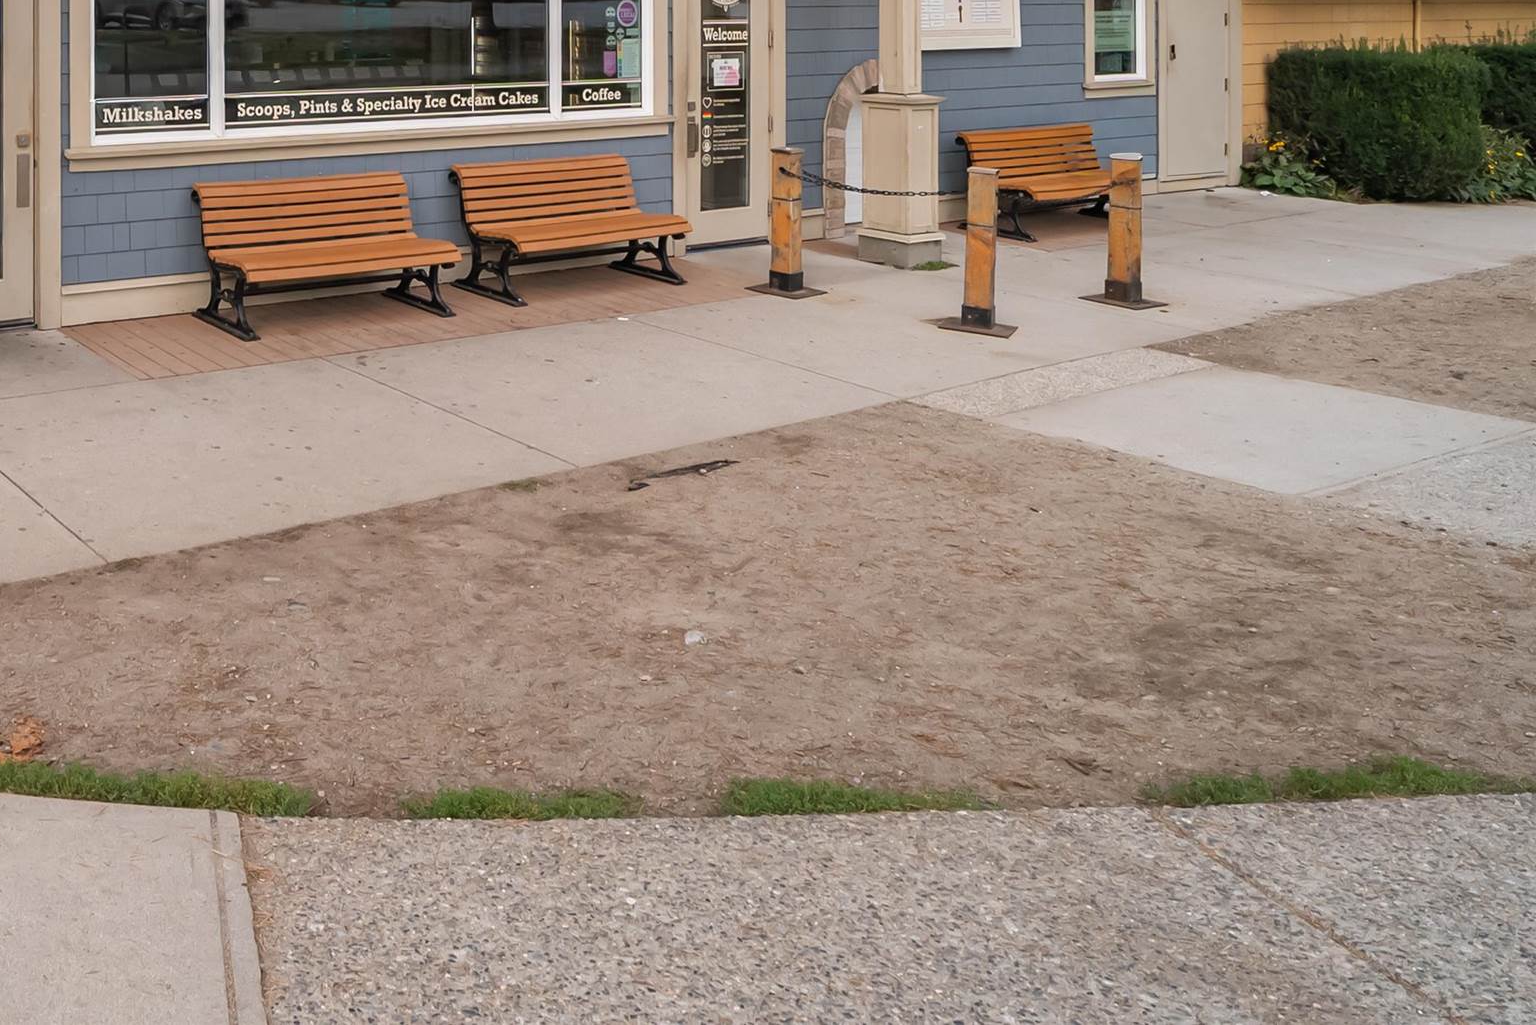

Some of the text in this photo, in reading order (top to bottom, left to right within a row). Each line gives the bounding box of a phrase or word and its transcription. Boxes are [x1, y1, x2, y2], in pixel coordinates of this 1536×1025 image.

[703, 27, 748, 41] Welcome
[582, 88, 622, 102] Coffee
[237, 91, 539, 119] Scoops, Pints & Specialty Ice Cream Cakes
[102, 105, 202, 124] Milkshakes
